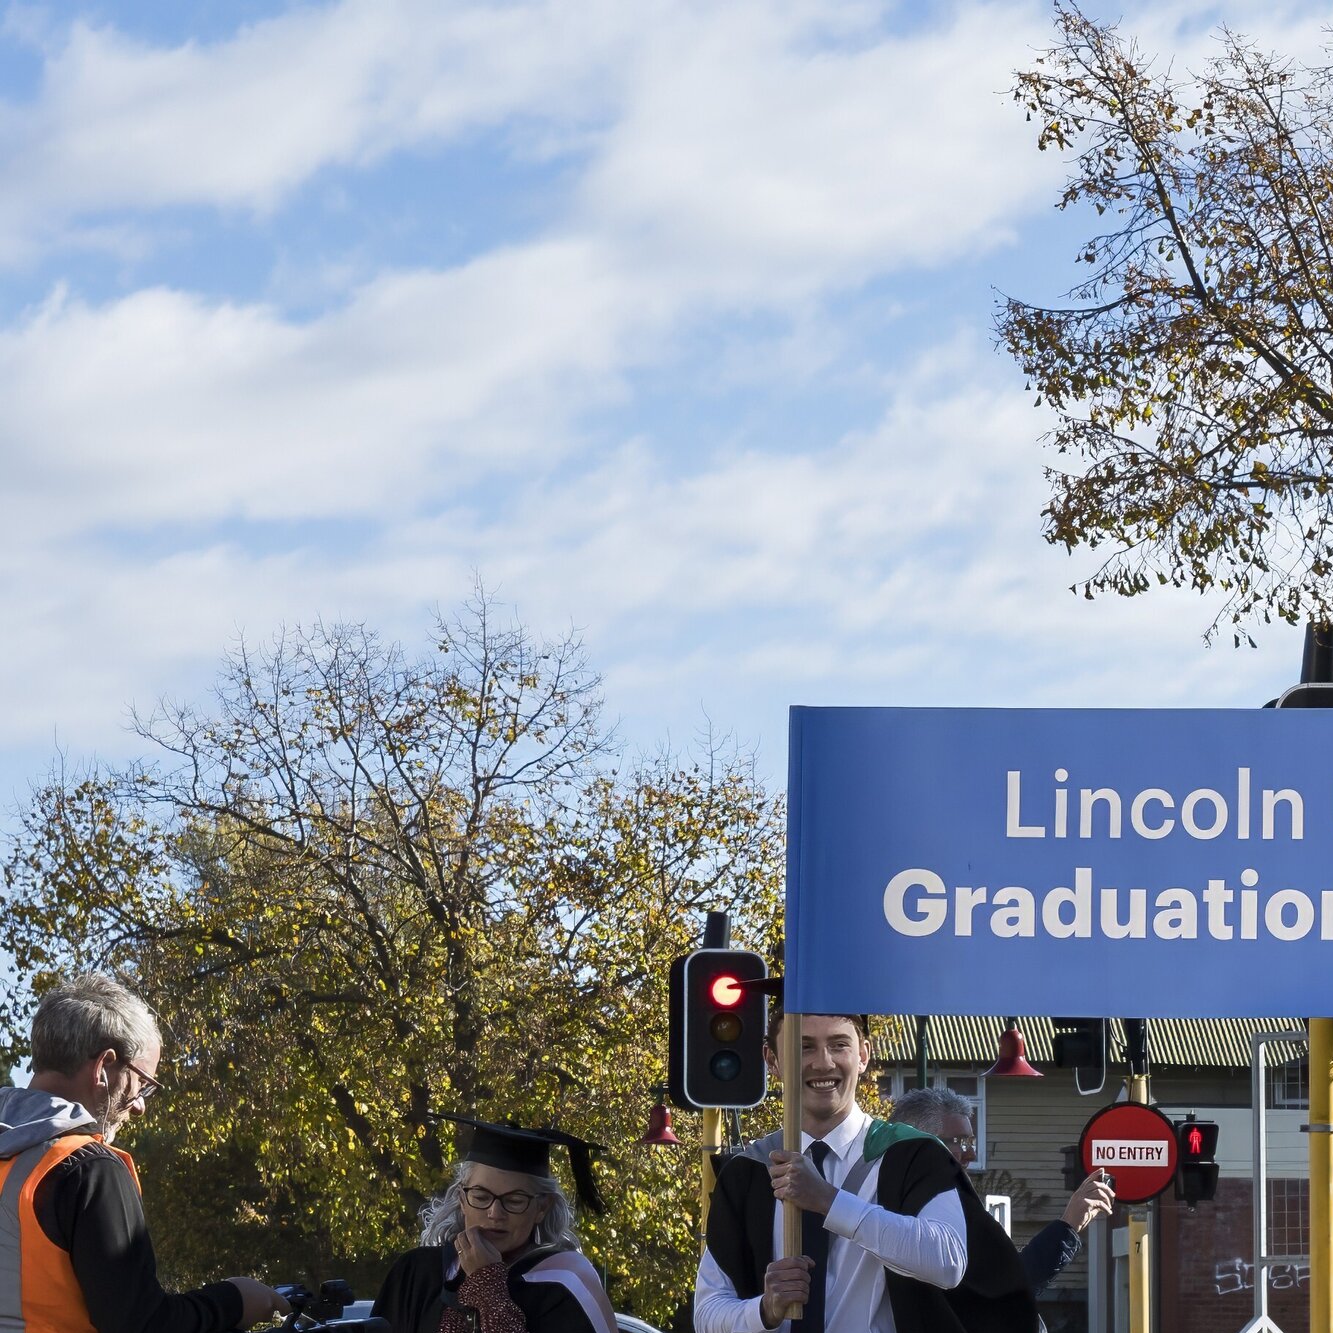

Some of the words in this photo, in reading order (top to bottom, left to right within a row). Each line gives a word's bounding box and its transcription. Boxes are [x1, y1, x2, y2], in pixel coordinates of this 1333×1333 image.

[1004, 767, 1305, 840] Lincoln
[1096, 1146, 1116, 1161] NO
[1119, 1146, 1164, 1161] ENTRY
